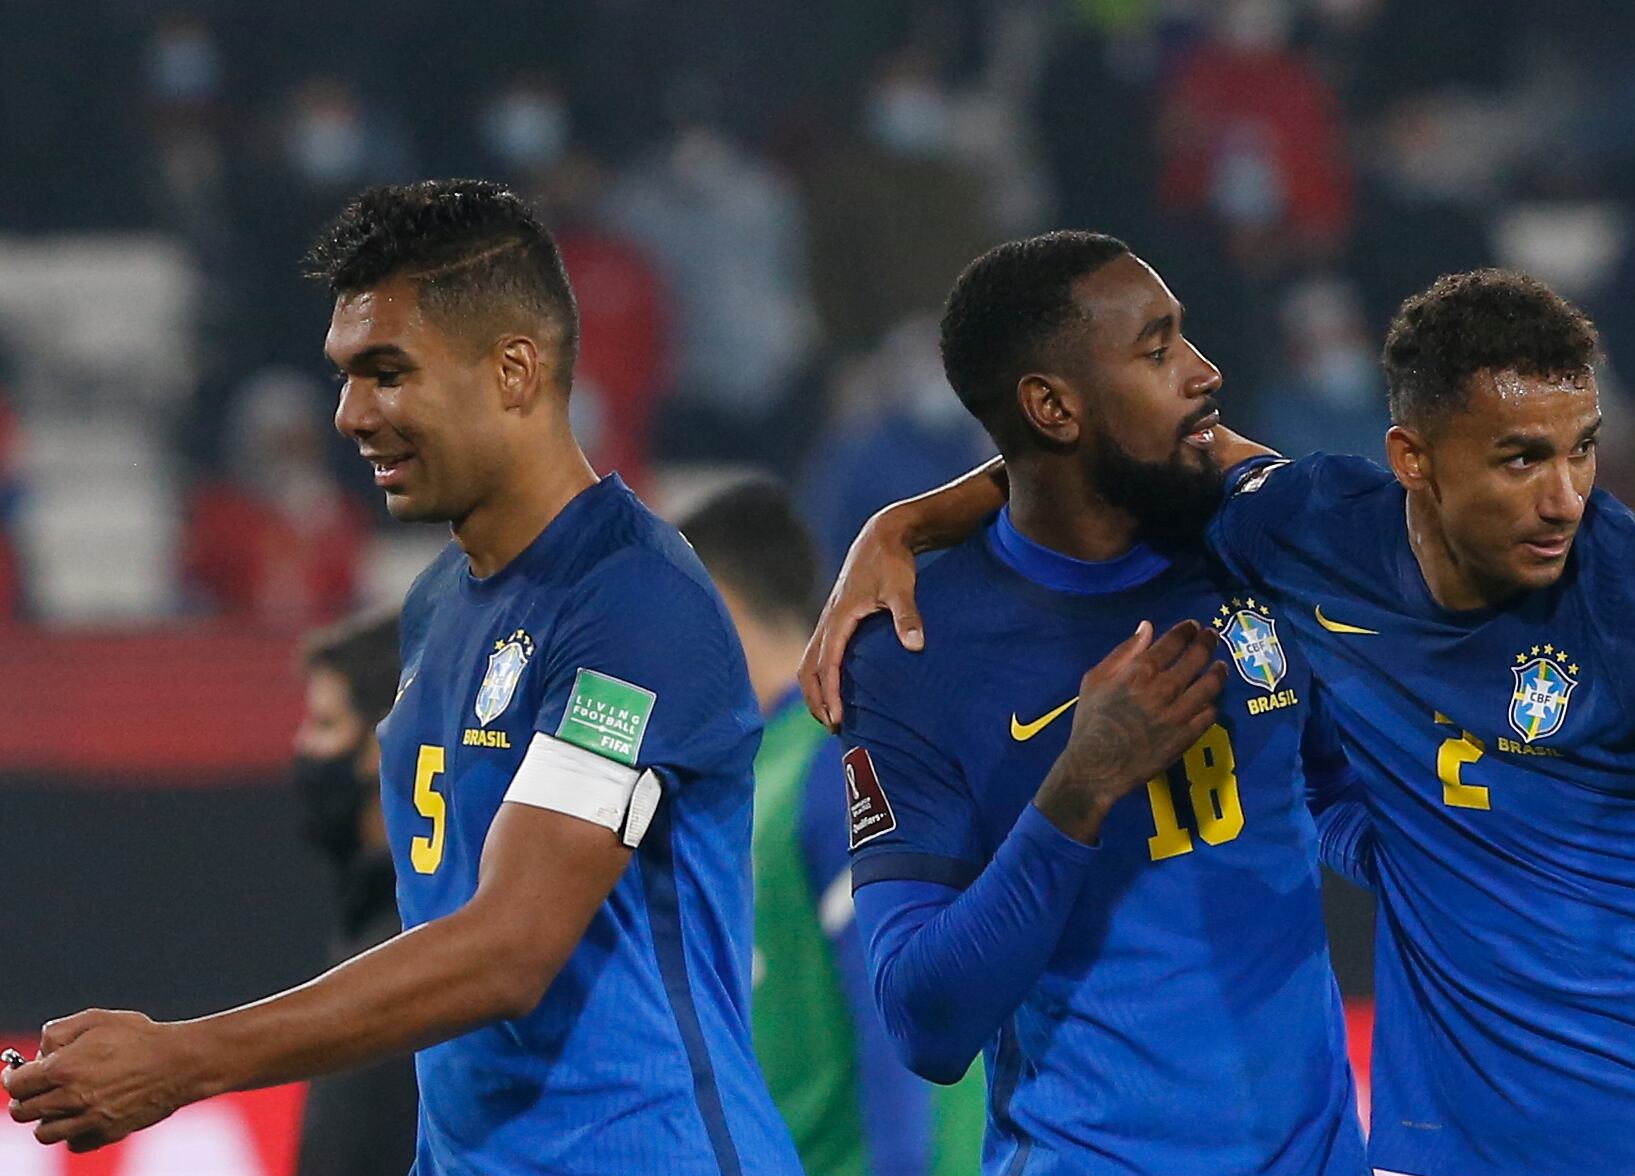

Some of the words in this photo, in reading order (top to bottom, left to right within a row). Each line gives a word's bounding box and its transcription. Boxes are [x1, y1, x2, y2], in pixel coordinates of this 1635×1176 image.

[1246, 640, 1266, 654] CBF
[576, 695, 641, 726] LIVING
[1247, 689, 1298, 715] BRASIL
[1529, 691, 1552, 704] CBF
[573, 705, 636, 735] FOOTBALL
[462, 729, 511, 749] BRASIL
[600, 735, 632, 755] FIFA
[1147, 723, 1245, 862] 18
[410, 744, 446, 874] 5
